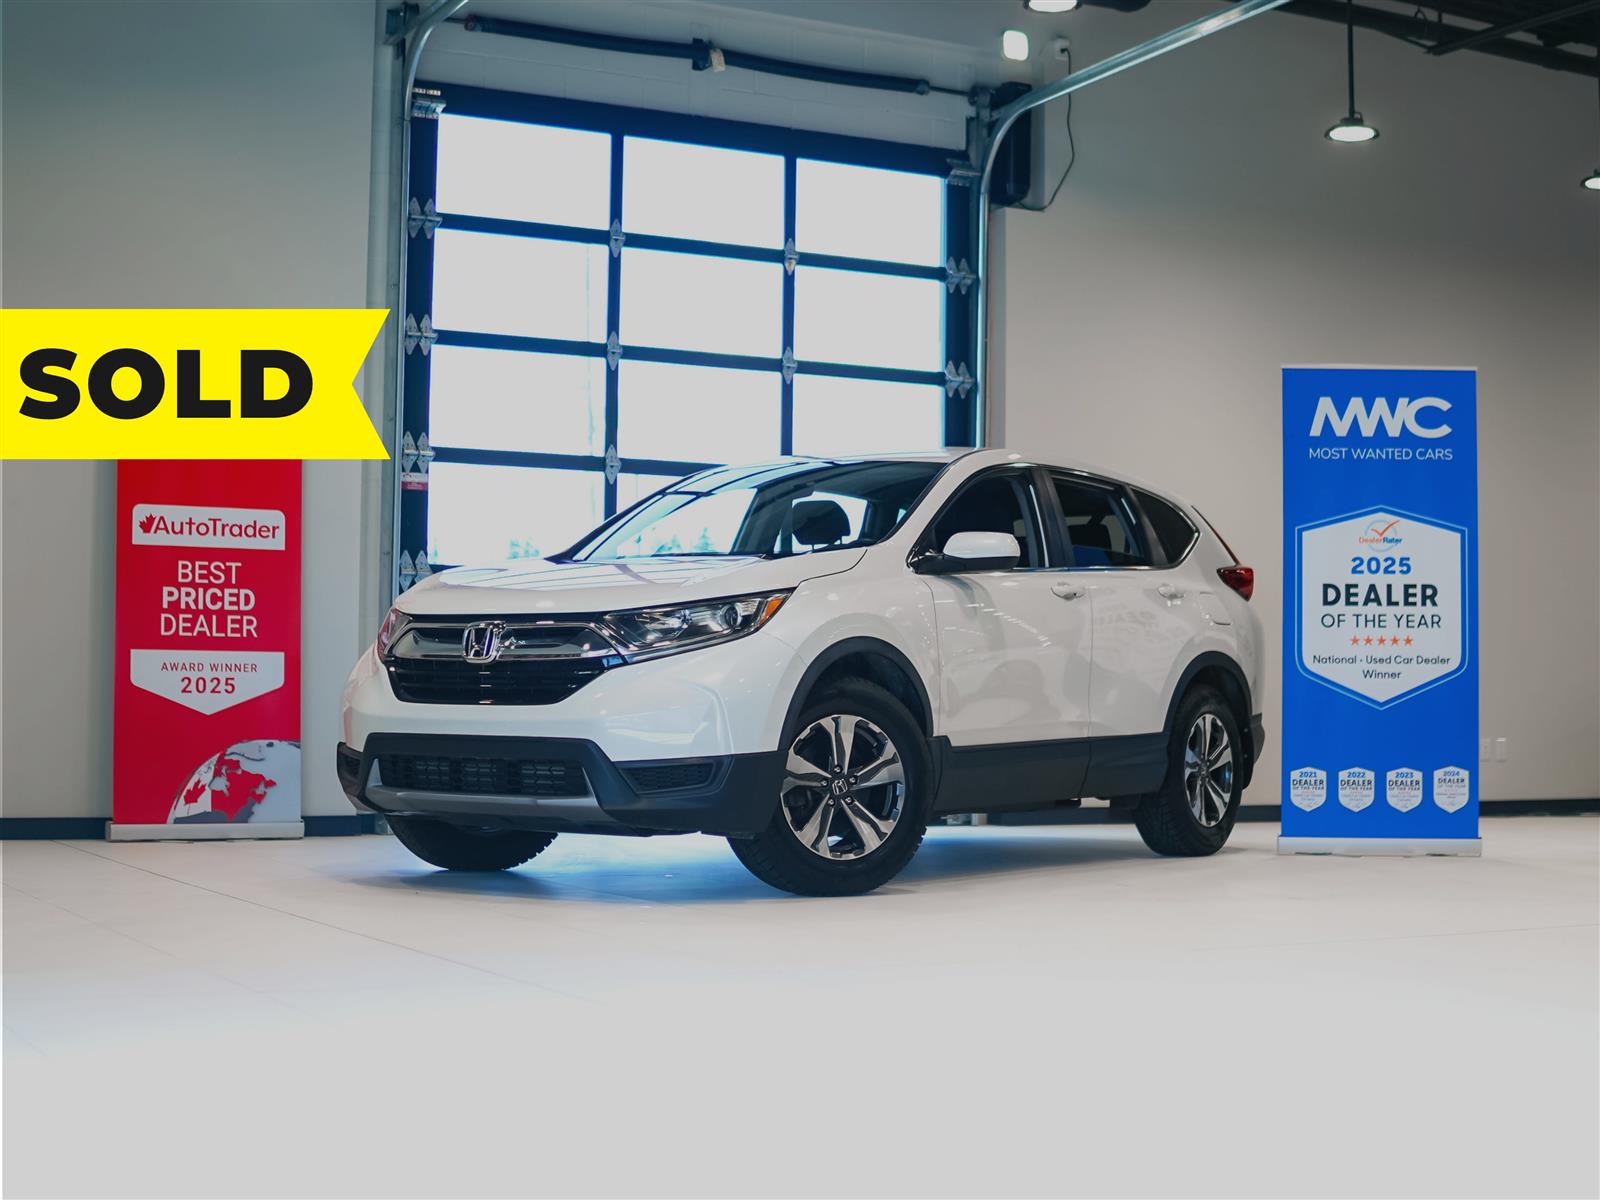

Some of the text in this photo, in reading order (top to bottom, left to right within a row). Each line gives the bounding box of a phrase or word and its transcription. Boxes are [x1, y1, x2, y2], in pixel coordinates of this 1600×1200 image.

[1309, 396, 1452, 438] MWC
[1309, 448, 1453, 460] MOST WANTED CARS
[153, 515, 280, 539] AutoTrader
[178, 560, 242, 584] BEST
[1350, 556, 1412, 575] 2025
[162, 586, 256, 611] PRICED
[1322, 583, 1438, 607] DEALER
[160, 613, 258, 638] DEALER
[1320, 613, 1441, 629] OF THE YEAR
[161, 662, 258, 673] AWARD WINNER
[1313, 655, 1357, 665] National
[1366, 655, 1391, 665] Used
[1394, 655, 1413, 665] Car
[1416, 655, 1451, 665] Dealer
[1362, 669, 1402, 679] Winner
[180, 677, 236, 694] 2025
